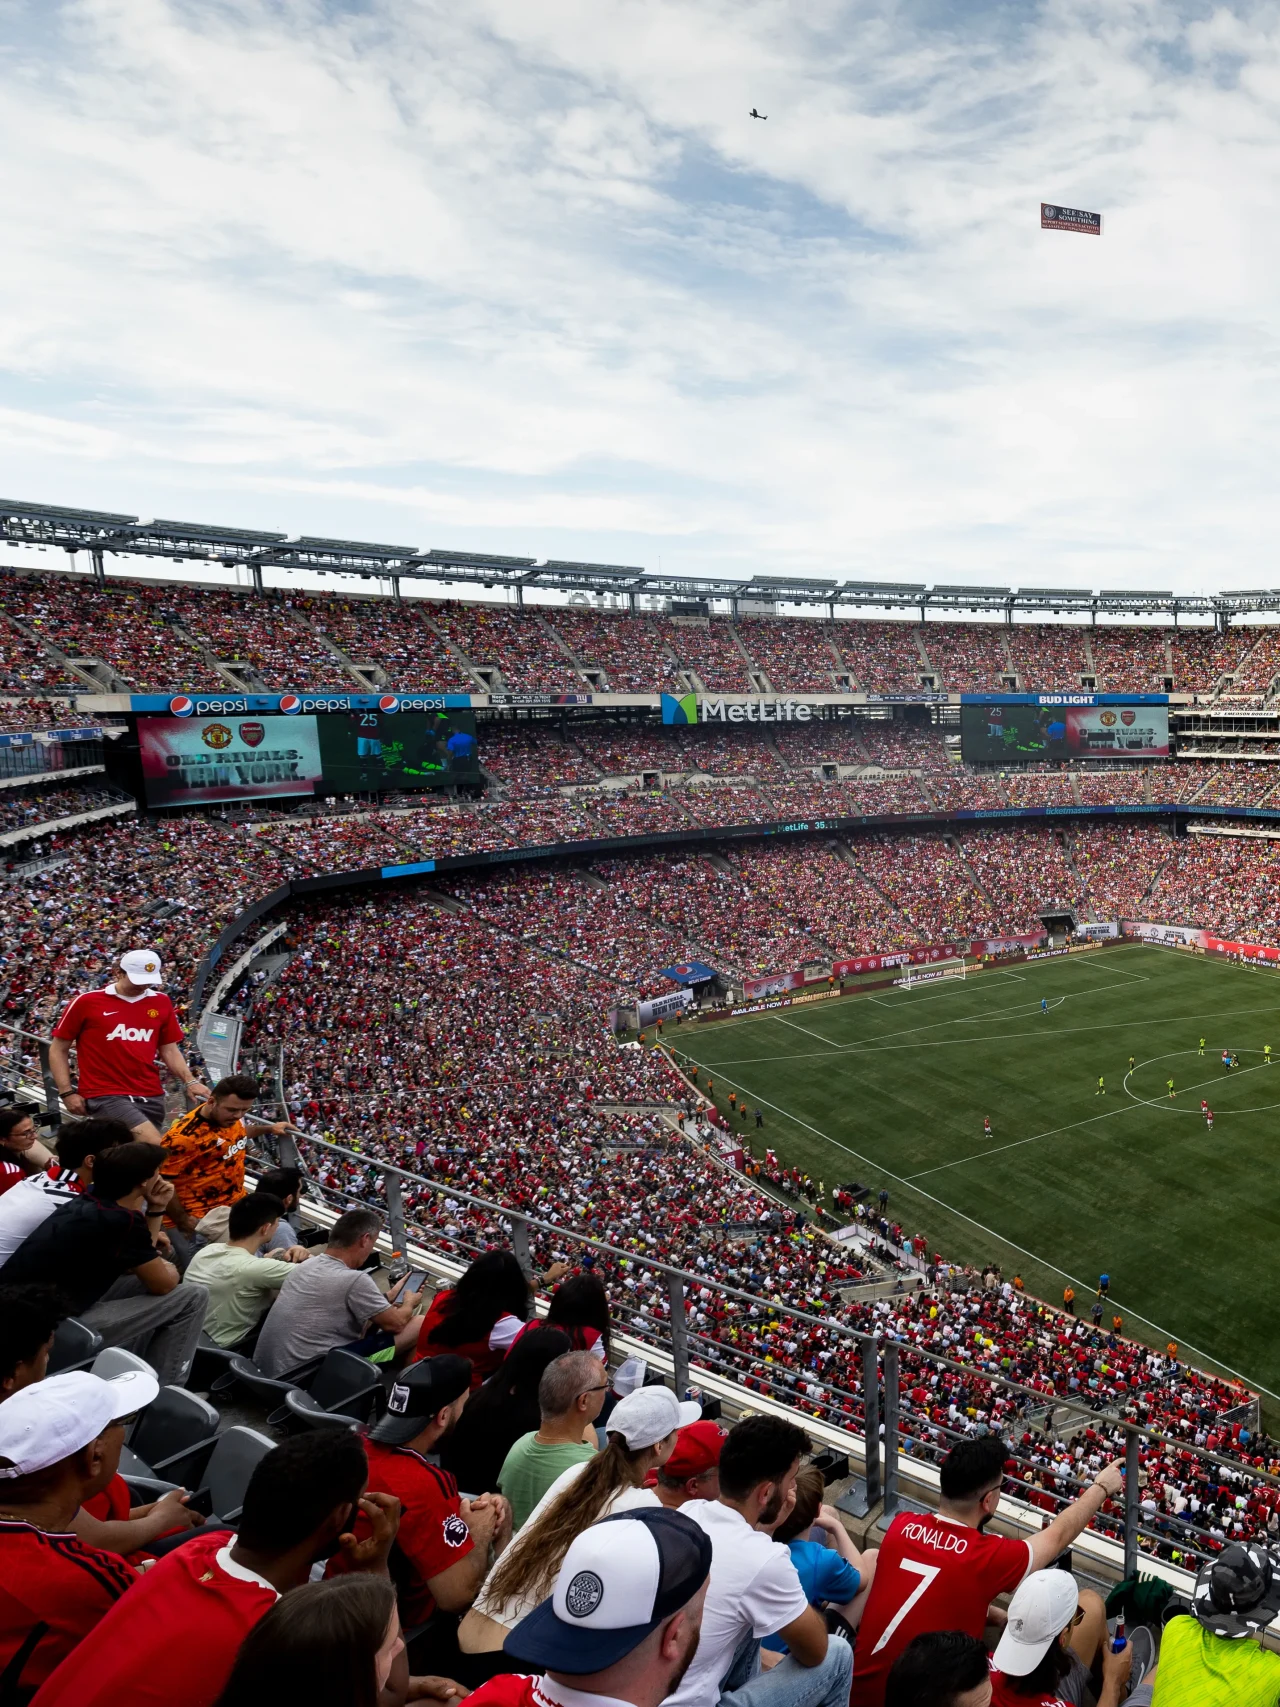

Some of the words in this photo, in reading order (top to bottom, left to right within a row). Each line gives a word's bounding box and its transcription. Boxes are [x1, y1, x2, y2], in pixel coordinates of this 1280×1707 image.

[1058, 214, 1098, 226] SOMETHING
[1062, 208, 1077, 217] SEE
[1079, 211, 1094, 220] SAY
[302, 697, 351, 712] pepsi
[400, 697, 446, 711] pepsi
[1039, 695, 1063, 704] BUD
[1065, 695, 1094, 704] LIGHT
[196, 698, 248, 715] pepsi
[701, 699, 811, 722] MetLife
[989, 707, 1002, 717] 25
[360, 713, 378, 727] 25
[166, 754, 211, 767] OLD
[975, 809, 1022, 818] ticketmaster
[1046, 807, 1093, 815] ticketmaster
[1115, 805, 1160, 813] ticketmaster
[777, 822, 809, 833] MetLife
[652, 1004, 668, 1017] NEW
[731, 1004, 766, 1016] AVAILABLE
[766, 1001, 783, 1009] NOW
[223, 1135, 248, 1160] Jee
[901, 1522, 968, 1554] RONALDO
[574, 1586, 592, 1602] VANS
[871, 1557, 941, 1656] 7
